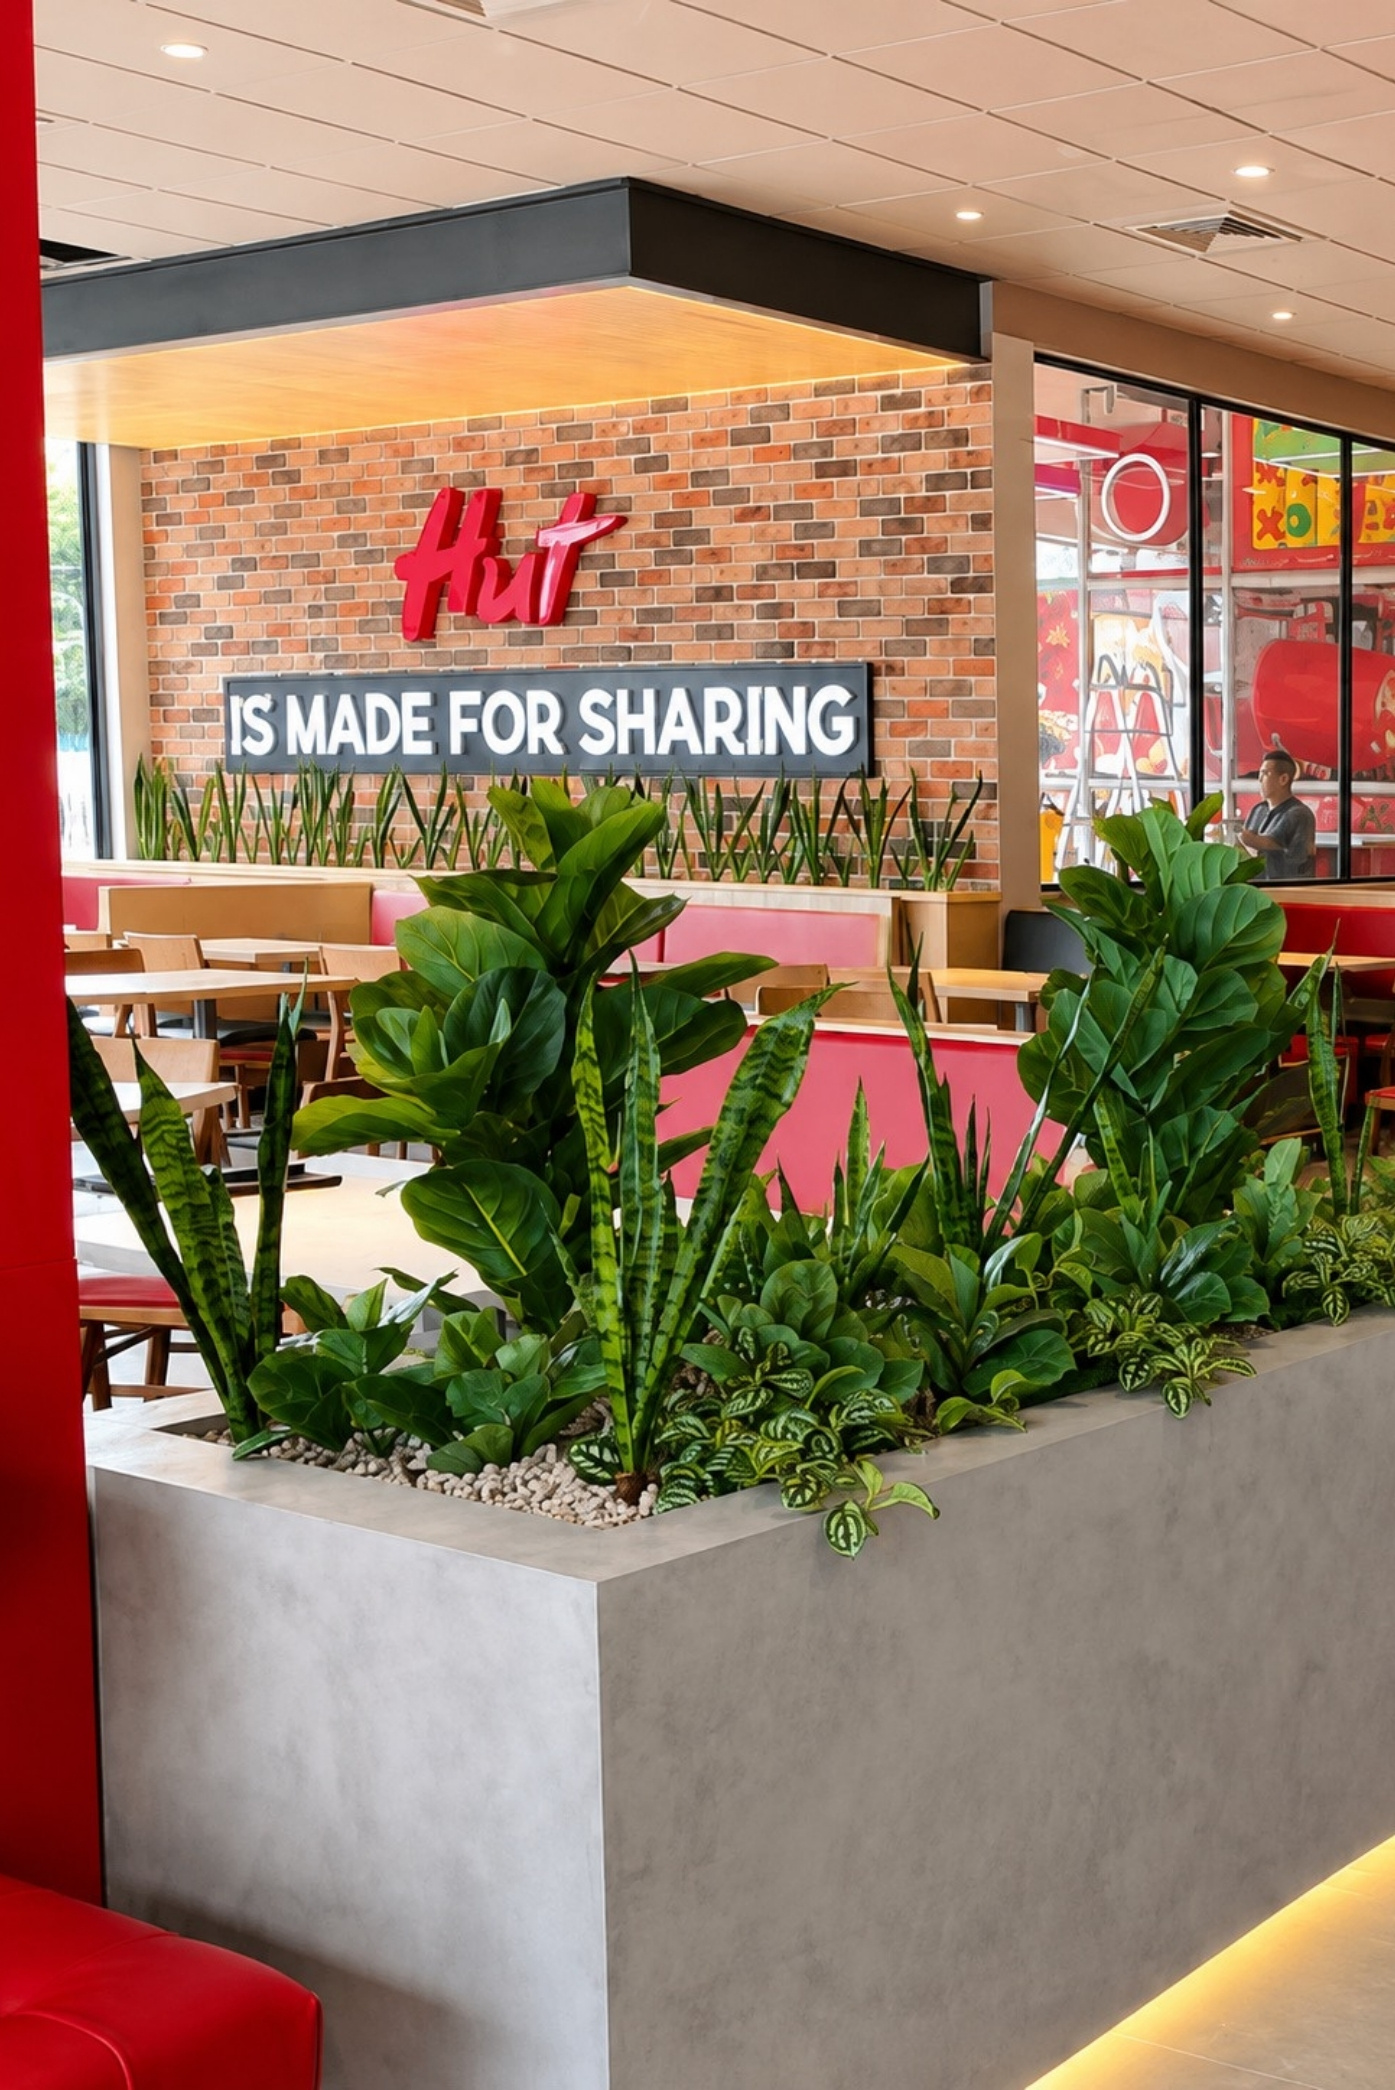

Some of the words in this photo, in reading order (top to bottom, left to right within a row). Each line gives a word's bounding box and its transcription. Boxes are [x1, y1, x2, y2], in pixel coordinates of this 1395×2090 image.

[394, 487, 627, 641] Hut
[230, 694, 274, 756] IS
[287, 691, 435, 755] MADE
[449, 689, 563, 755] FOR
[578, 685, 856, 756] SHARING
